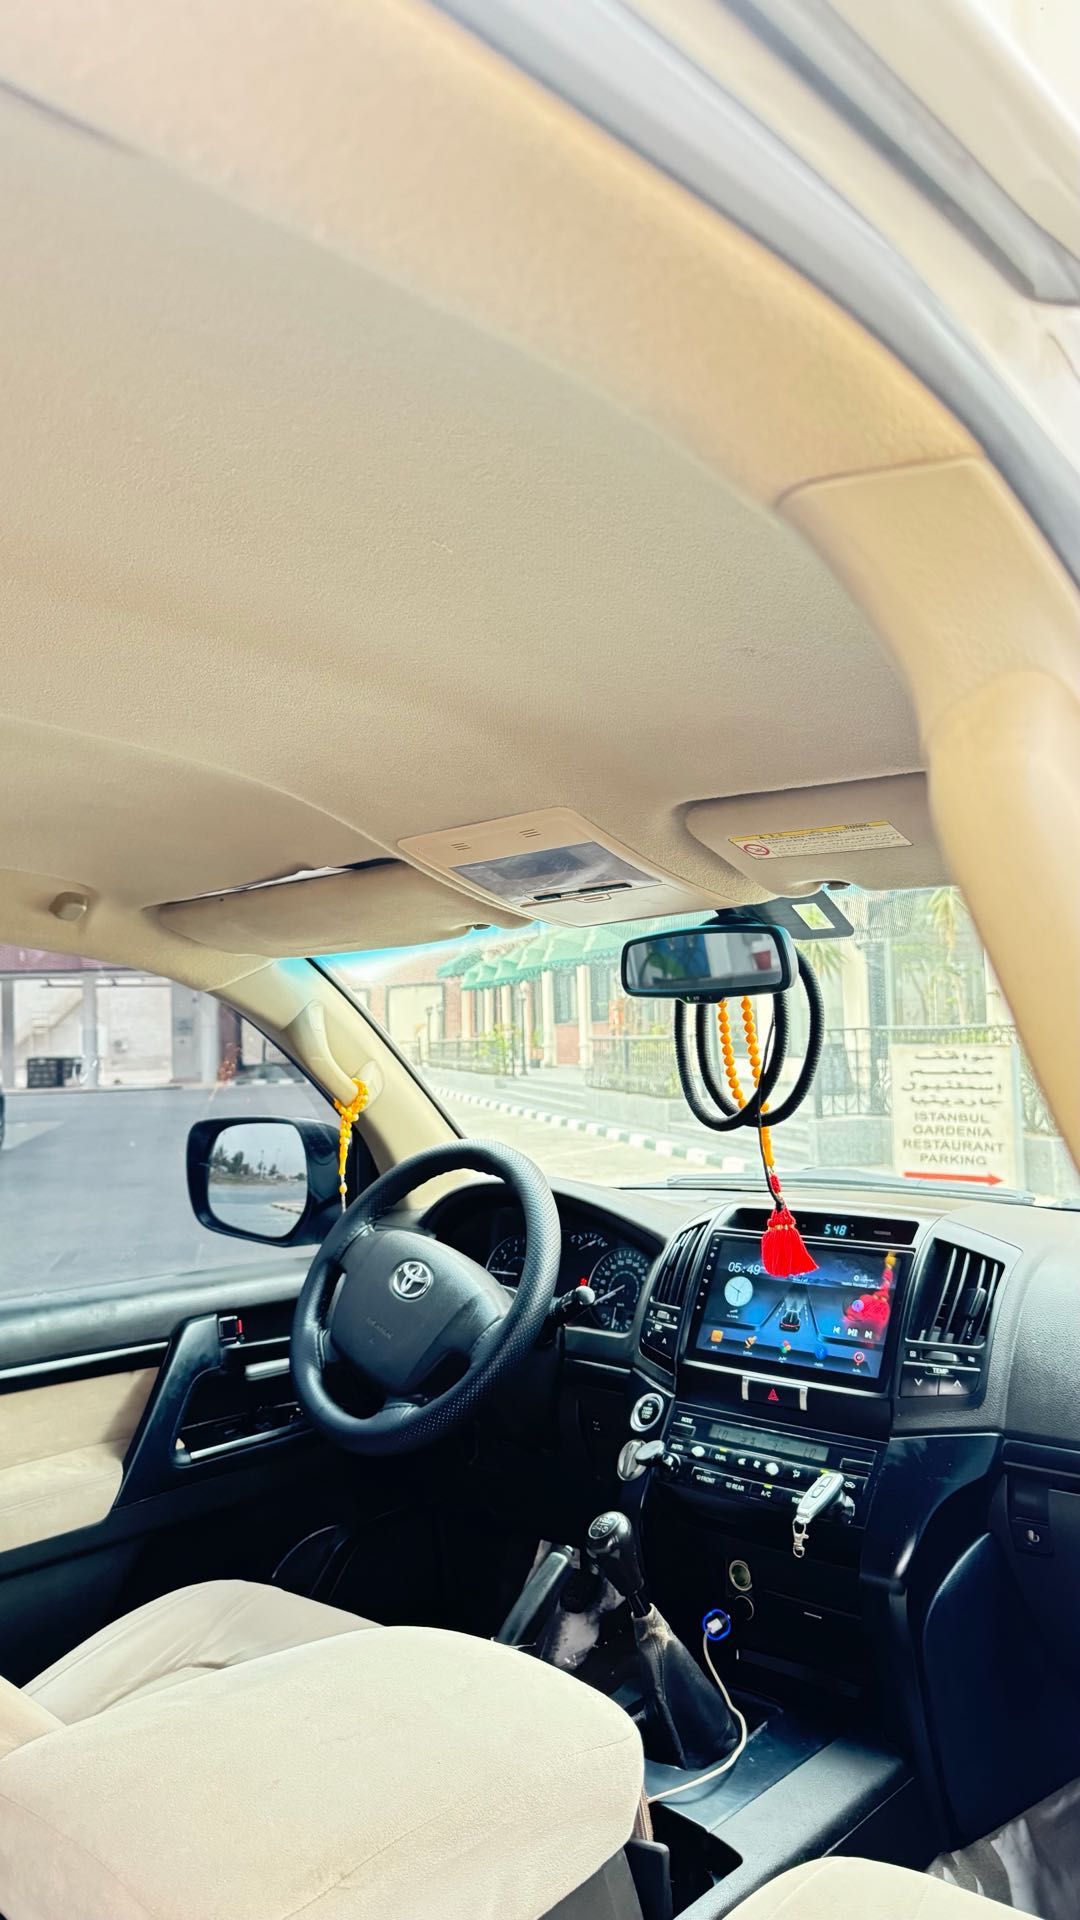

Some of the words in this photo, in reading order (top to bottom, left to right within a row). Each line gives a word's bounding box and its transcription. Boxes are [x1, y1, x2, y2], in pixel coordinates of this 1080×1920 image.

[910, 1067, 992, 1077] مطعم
[914, 1111, 990, 1123] ISTANBUL
[912, 1125, 992, 1137] GARDENIA
[902, 1139, 1004, 1153] RESTAURANT
[919, 1153, 987, 1165] PARKING
[728, 1261, 761, 1275] 05:49
[932, 1367, 949, 1375] TEMP
[760, 1490, 771, 1498] A/C
